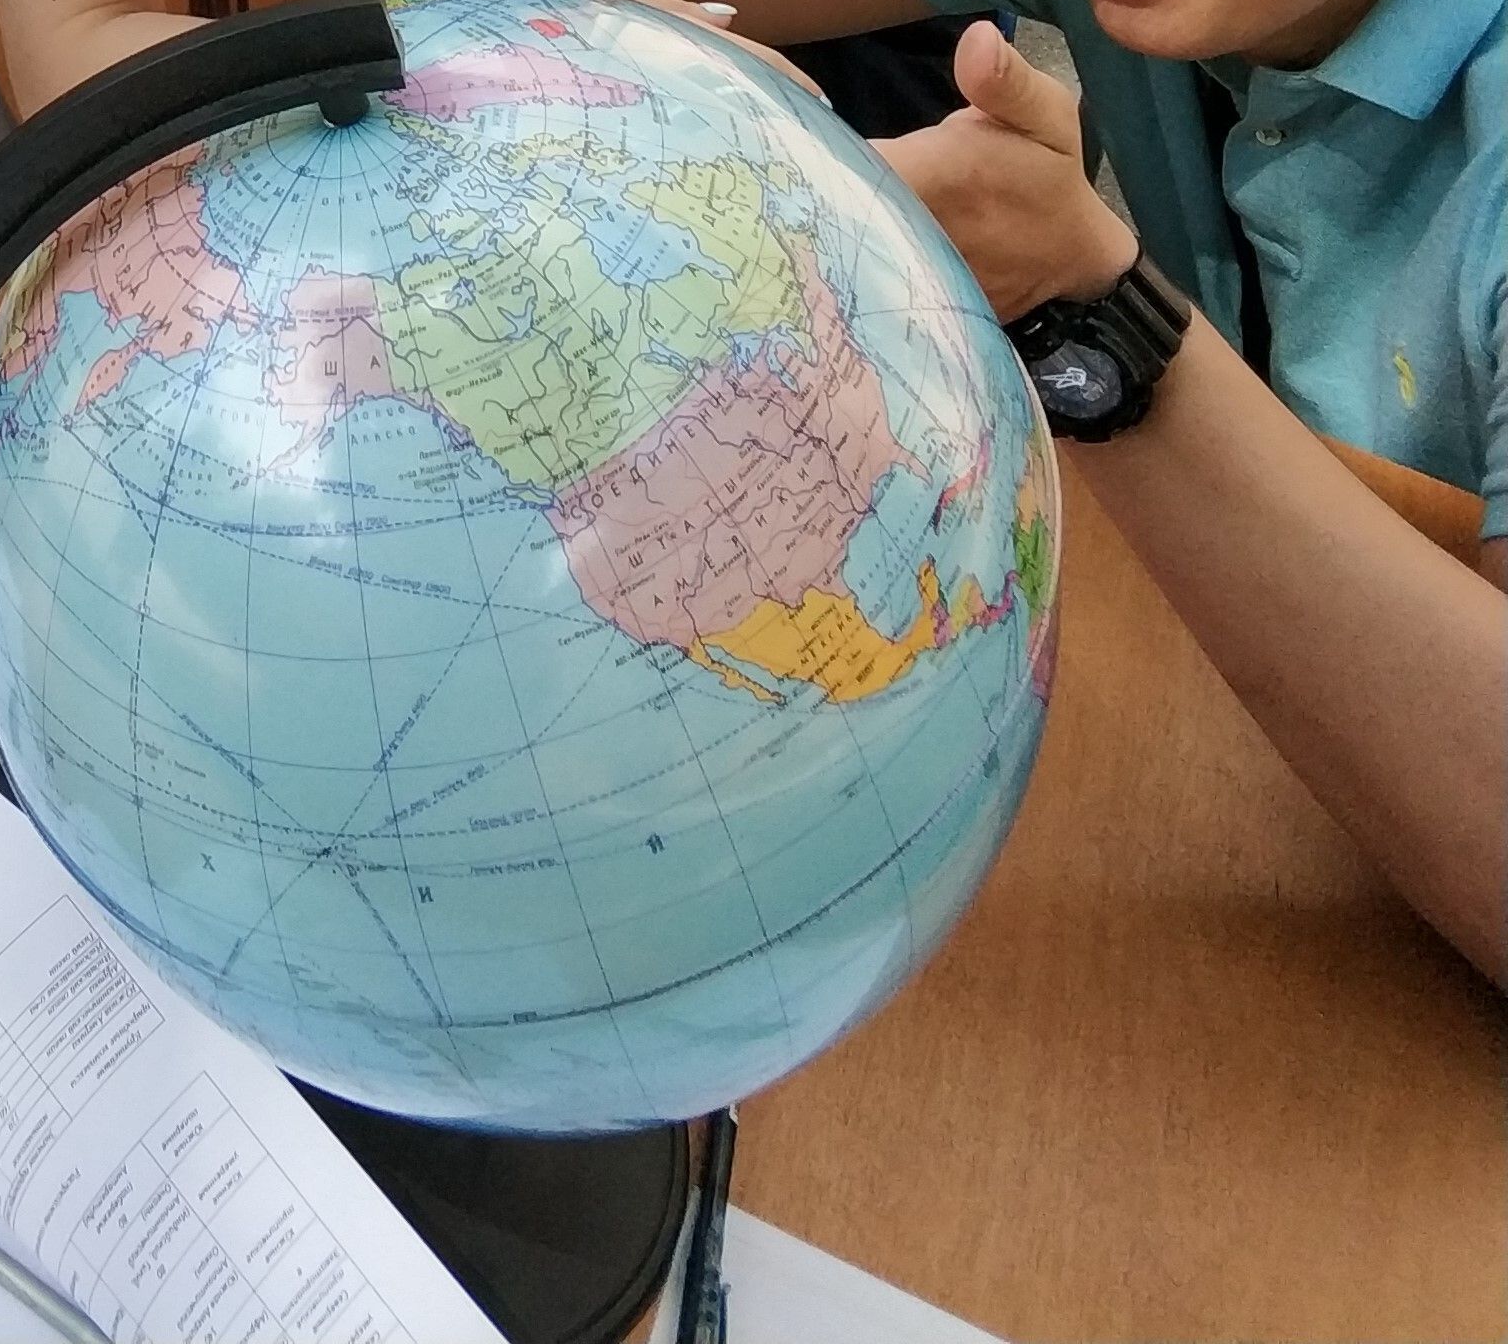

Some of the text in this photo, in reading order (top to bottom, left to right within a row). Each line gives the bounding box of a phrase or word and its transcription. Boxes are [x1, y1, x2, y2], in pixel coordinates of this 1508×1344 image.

[157, 1106, 202, 1153] полярные
[170, 1121, 206, 1159] Южные
[194, 1151, 244, 1203] умеренные
[209, 1168, 246, 1207] Южные
[241, 1203, 299, 1265] тропические
[261, 1227, 298, 1266] Южные
[205, 1269, 243, 1312] (Южная
